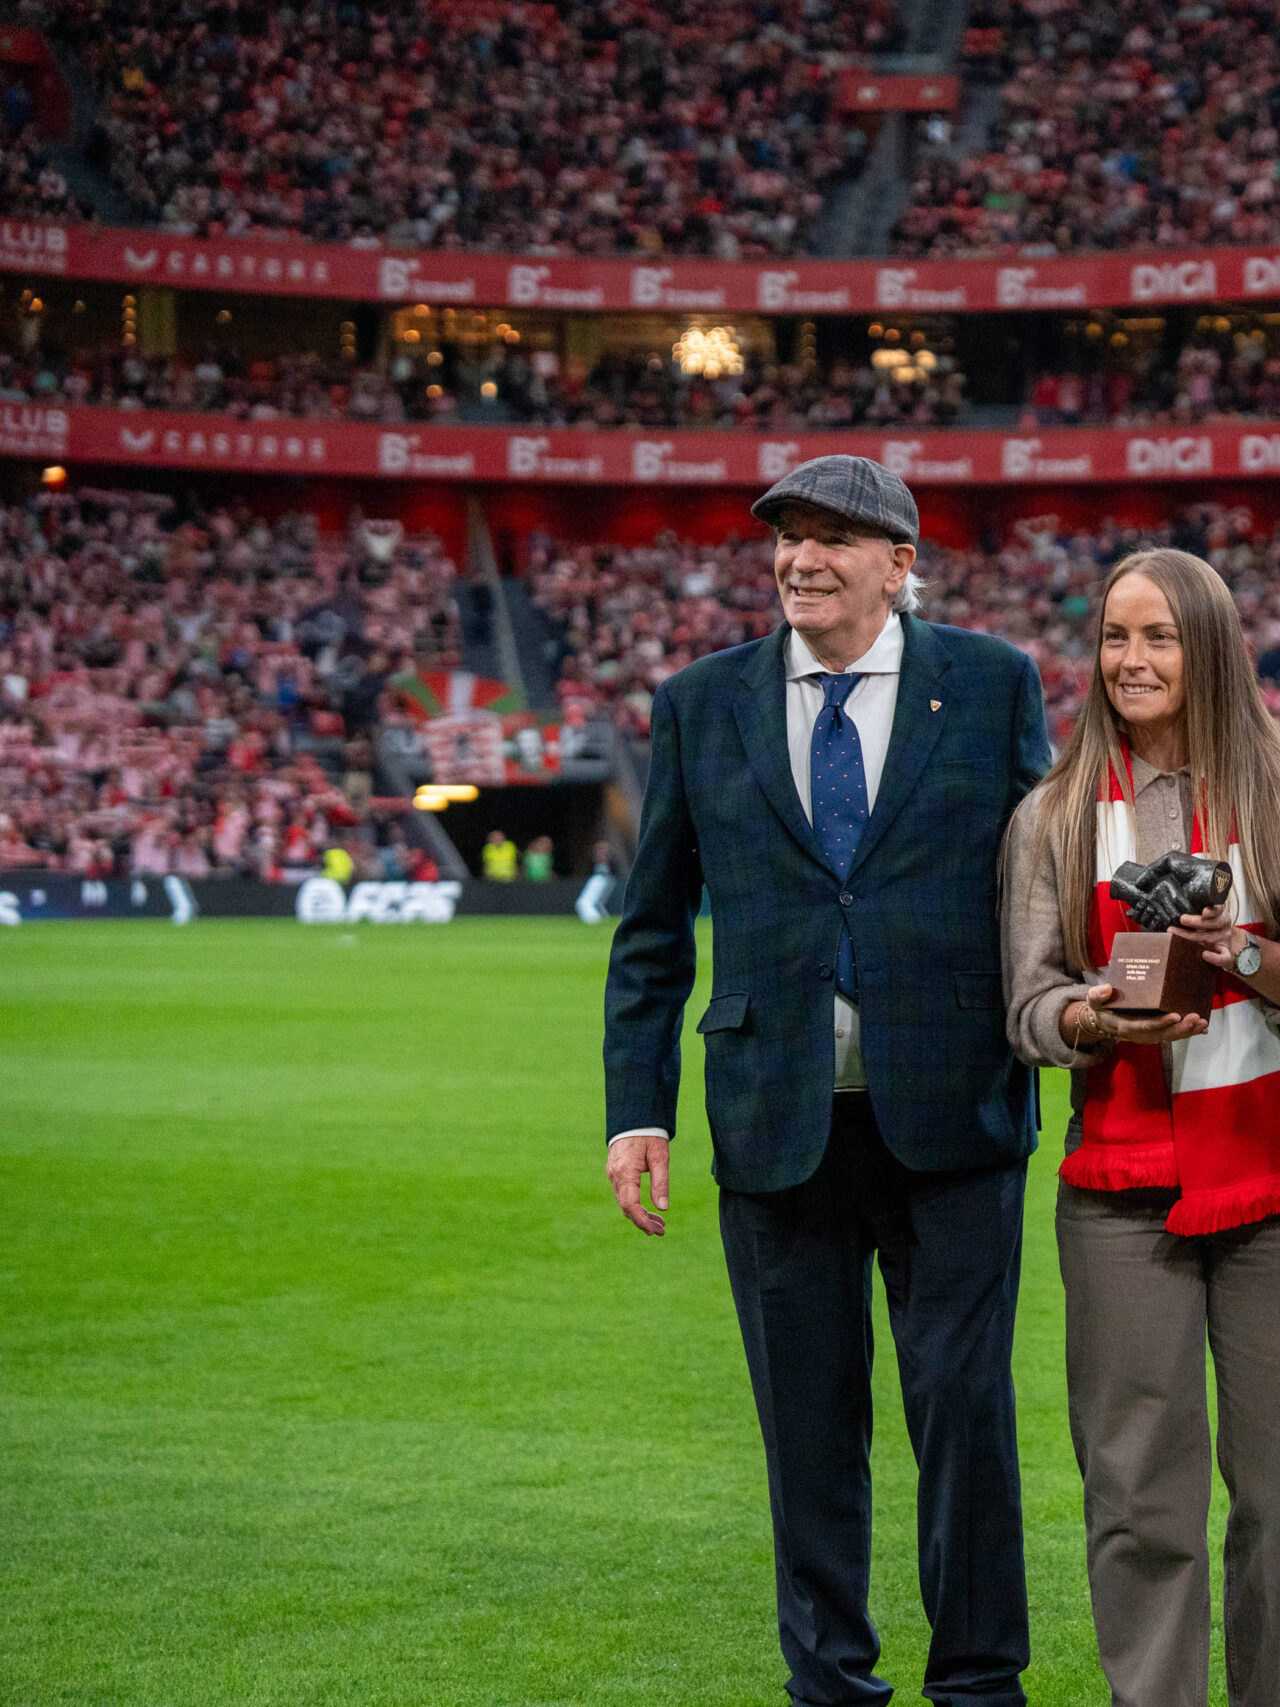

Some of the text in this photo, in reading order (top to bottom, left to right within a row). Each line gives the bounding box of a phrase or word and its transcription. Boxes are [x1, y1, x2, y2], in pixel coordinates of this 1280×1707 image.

[3, 222, 67, 251] LUB
[1130, 259, 1217, 299] DIGI
[4, 406, 68, 434] LUB
[1126, 436, 1213, 475] DIGI
